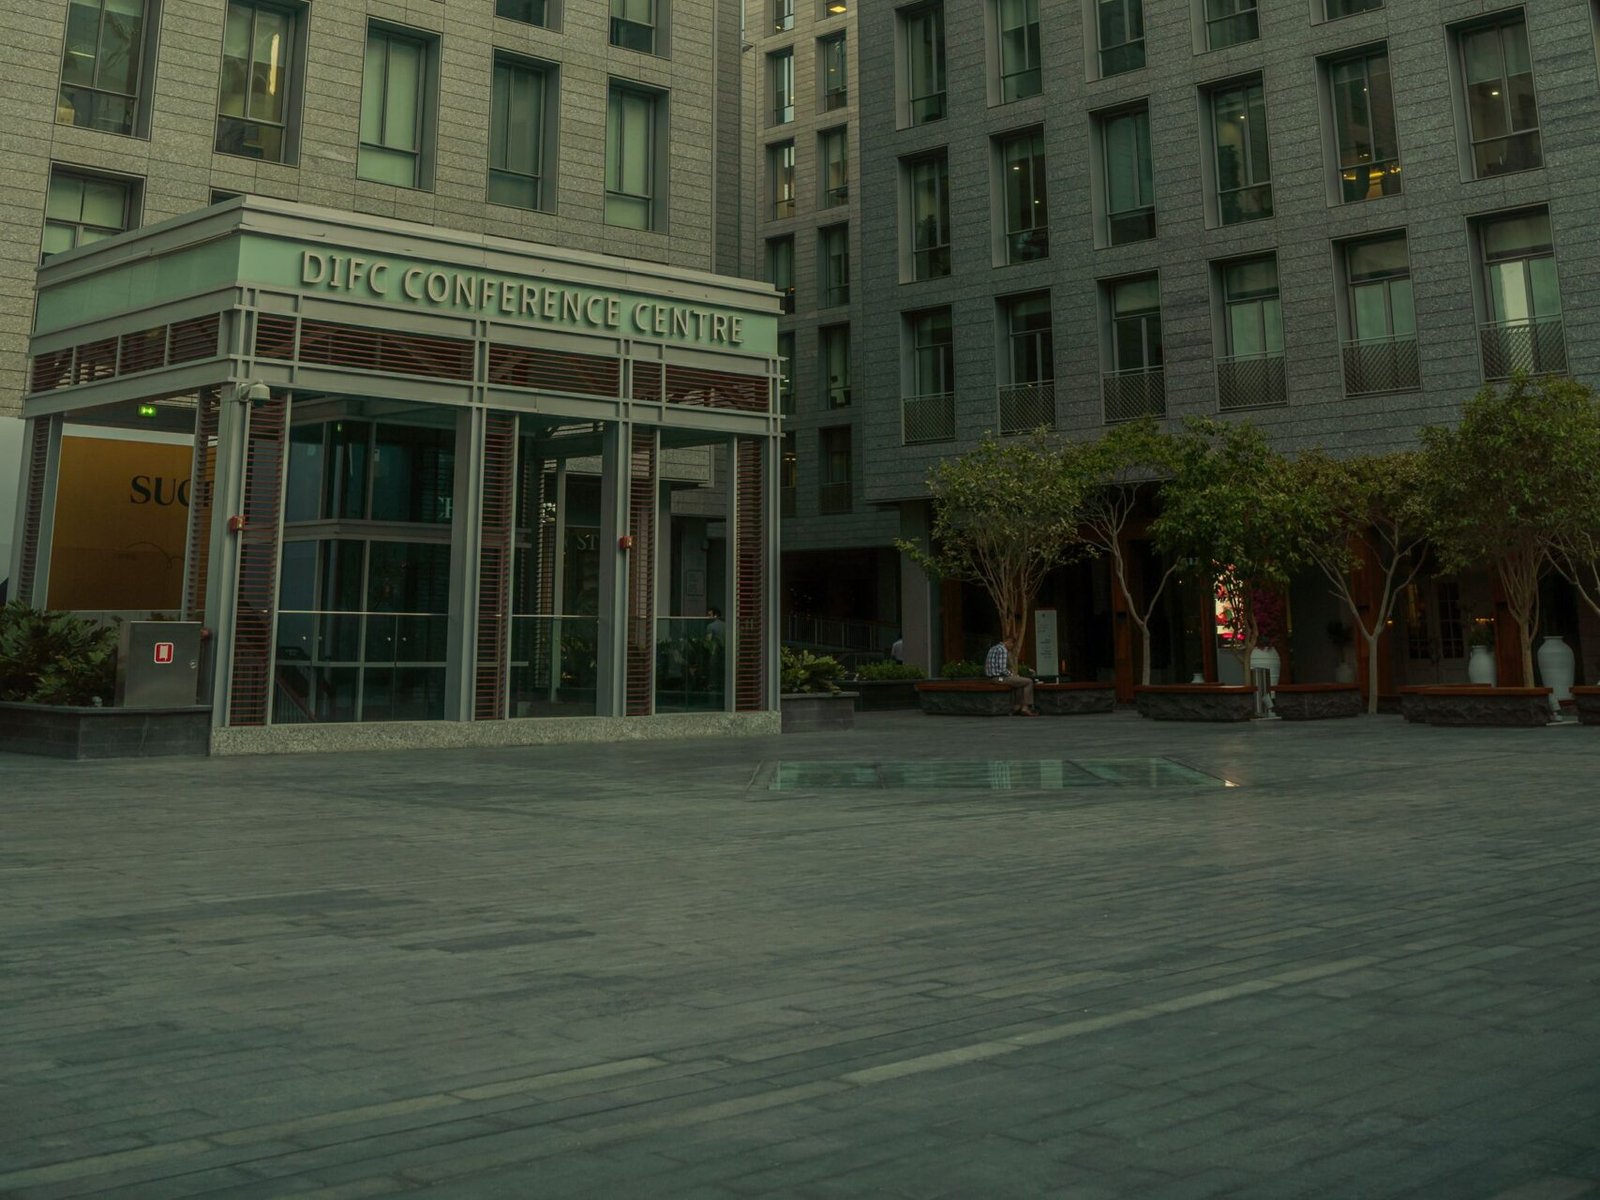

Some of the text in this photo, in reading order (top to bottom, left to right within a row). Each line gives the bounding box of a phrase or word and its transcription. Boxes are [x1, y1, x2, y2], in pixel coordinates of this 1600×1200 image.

[300, 250, 744, 345] DIFC CONFERENCE CENTRE
